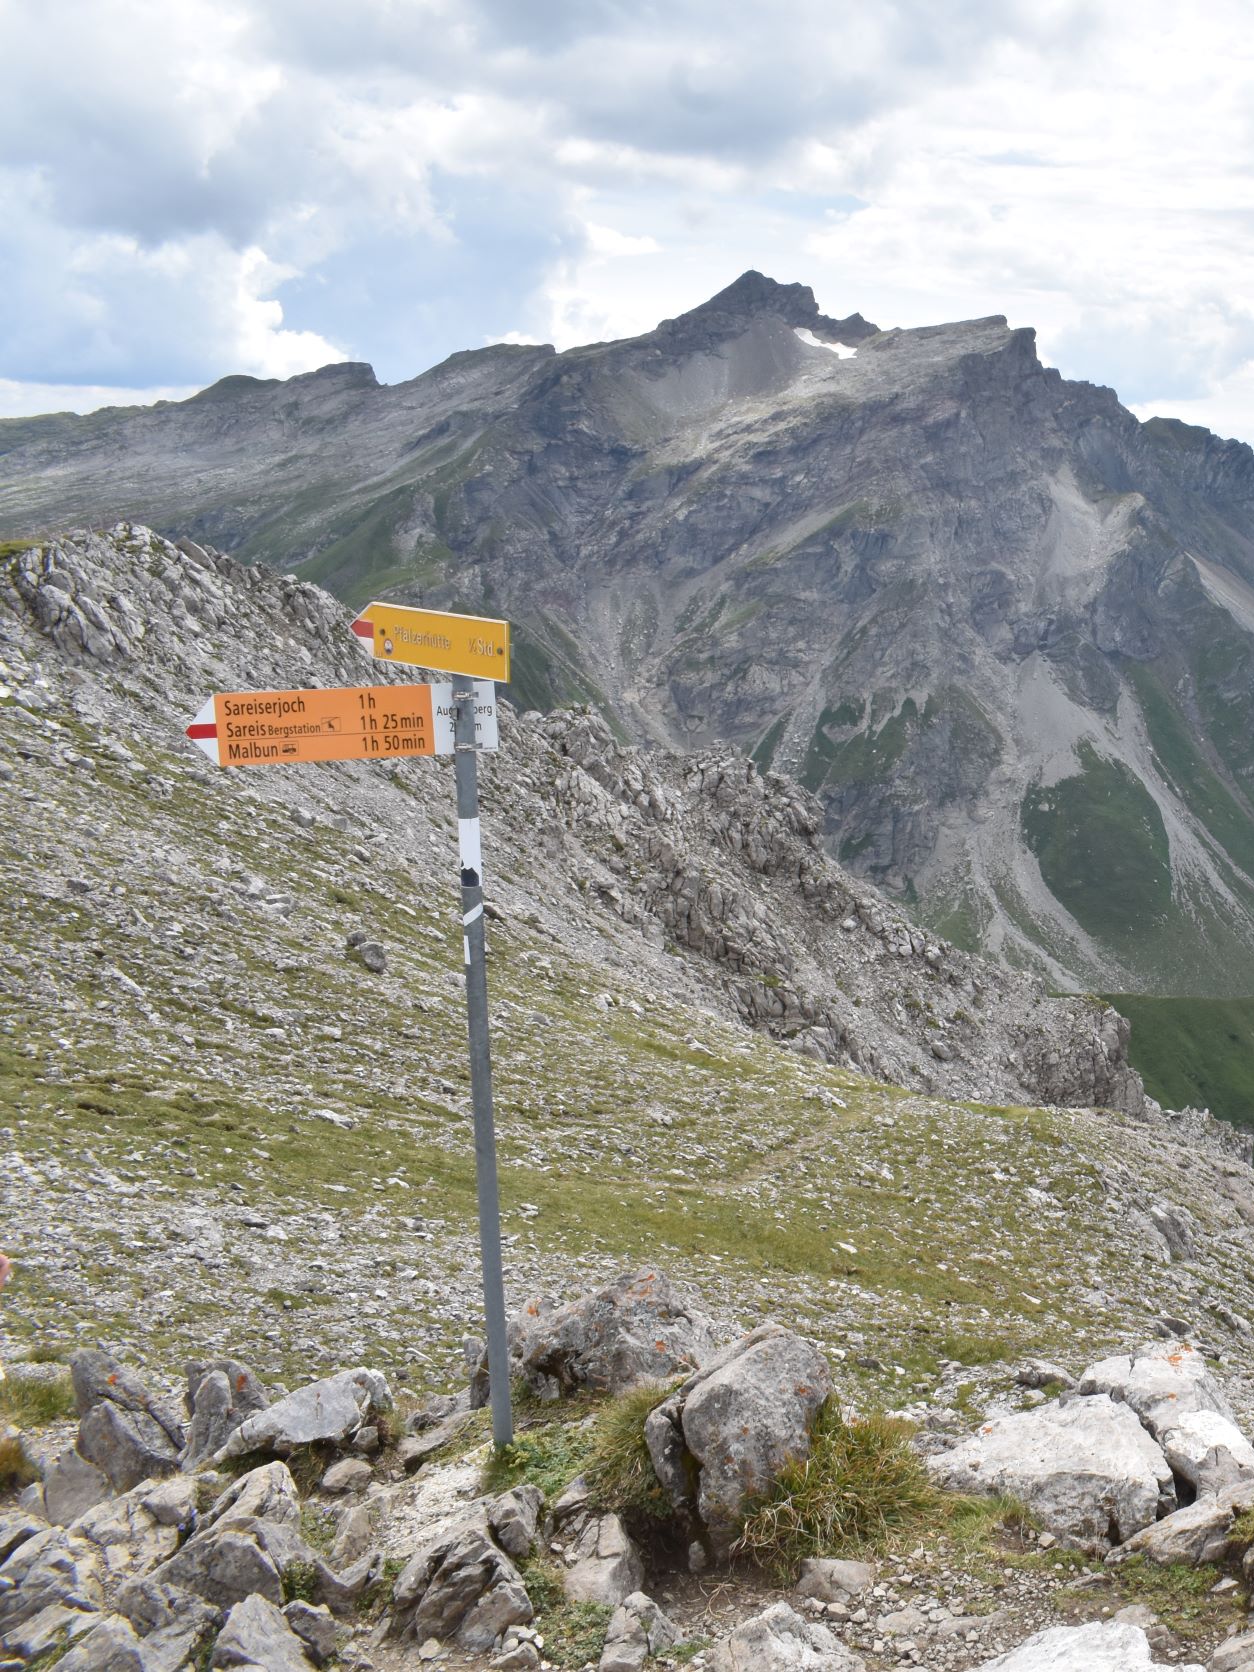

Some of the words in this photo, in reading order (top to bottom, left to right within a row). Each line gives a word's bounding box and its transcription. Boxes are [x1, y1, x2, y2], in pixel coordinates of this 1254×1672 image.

[224, 696, 305, 717] Sareiserjoch
[226, 721, 267, 738] Sareis
[267, 723, 321, 737] Bergstation
[383, 714, 398, 730] 25
[402, 713, 424, 730] min
[228, 742, 278, 760] Malbun
[385, 735, 399, 751] 50
[403, 734, 425, 750] min
